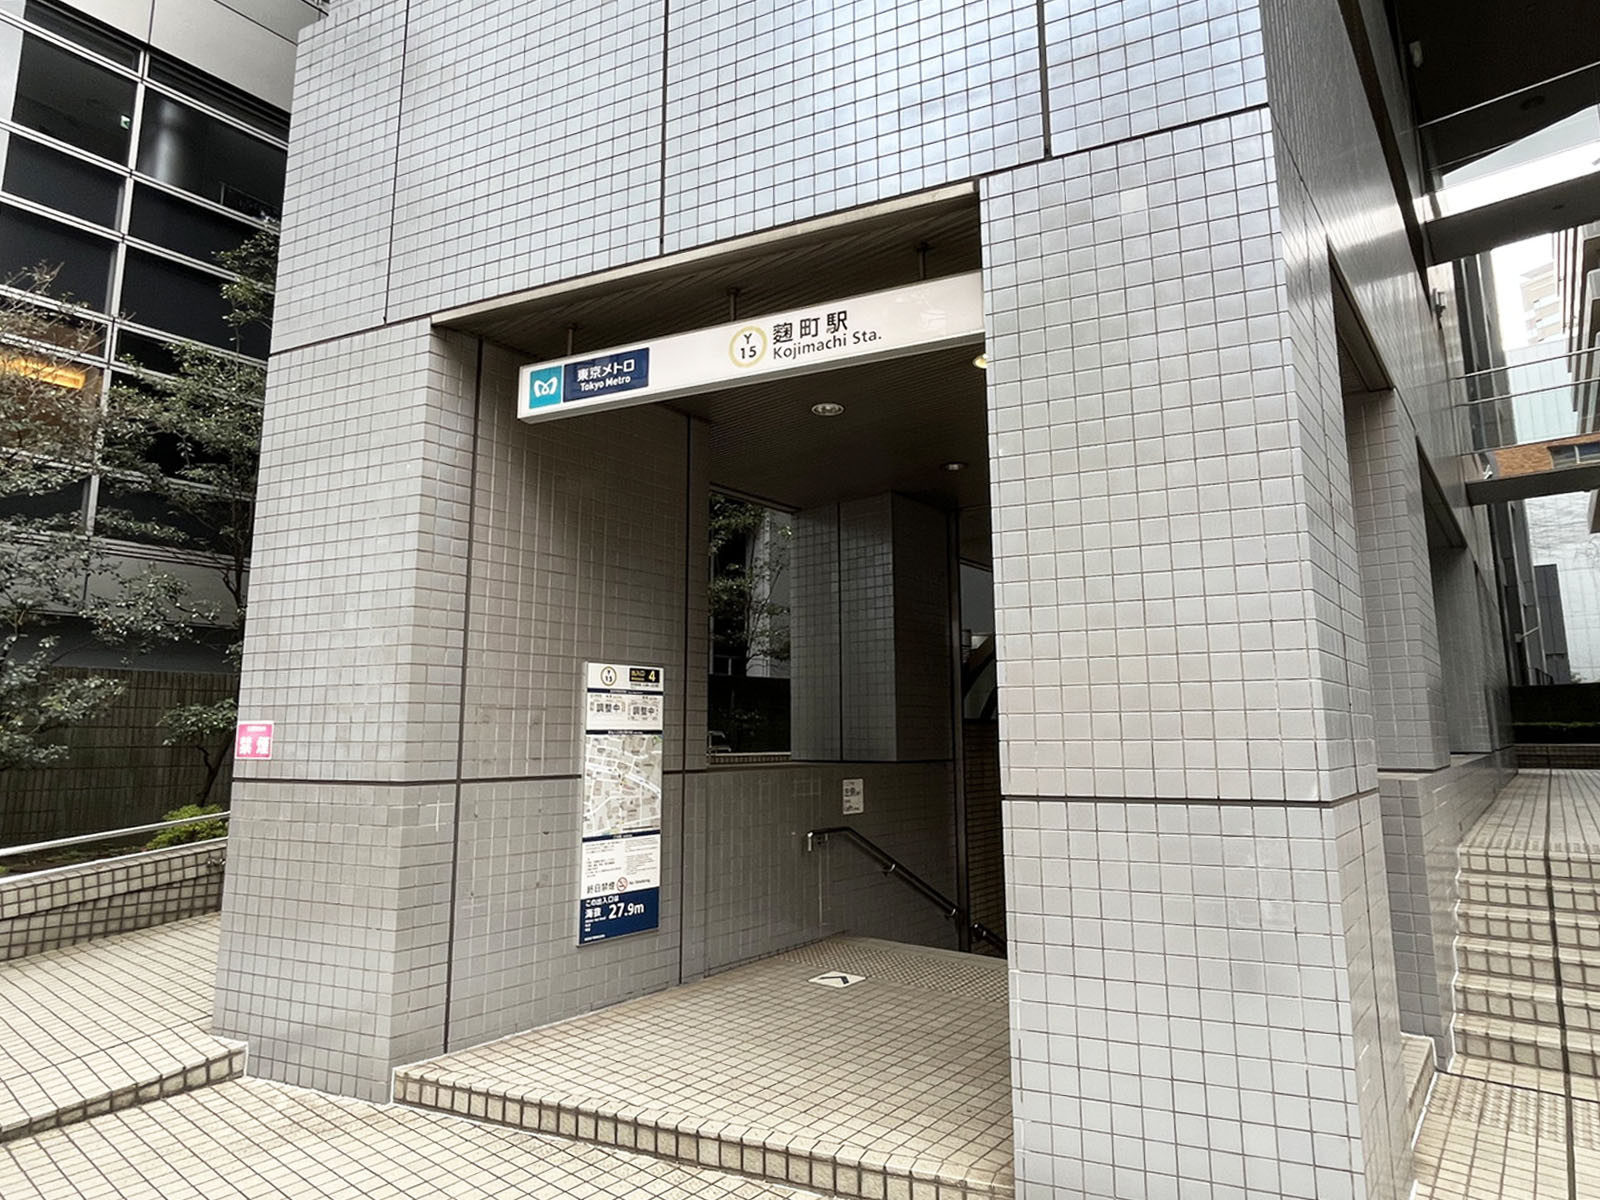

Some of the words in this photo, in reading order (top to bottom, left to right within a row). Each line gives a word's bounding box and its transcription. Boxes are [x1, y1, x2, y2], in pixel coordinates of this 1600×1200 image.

[744, 333, 752, 344] Y
[773, 333, 847, 359] Kojimachi
[852, 330, 882, 345] Sta.
[740, 346, 757, 359] 15
[577, 359, 635, 382] 東京メトロ
[580, 381, 605, 392] Tokyo
[605, 375, 631, 387] Metro
[605, 675, 613, 683] 15
[648, 670, 656, 682] 4
[585, 895, 619, 906] この出入口は
[608, 902, 645, 919] 27.9m
